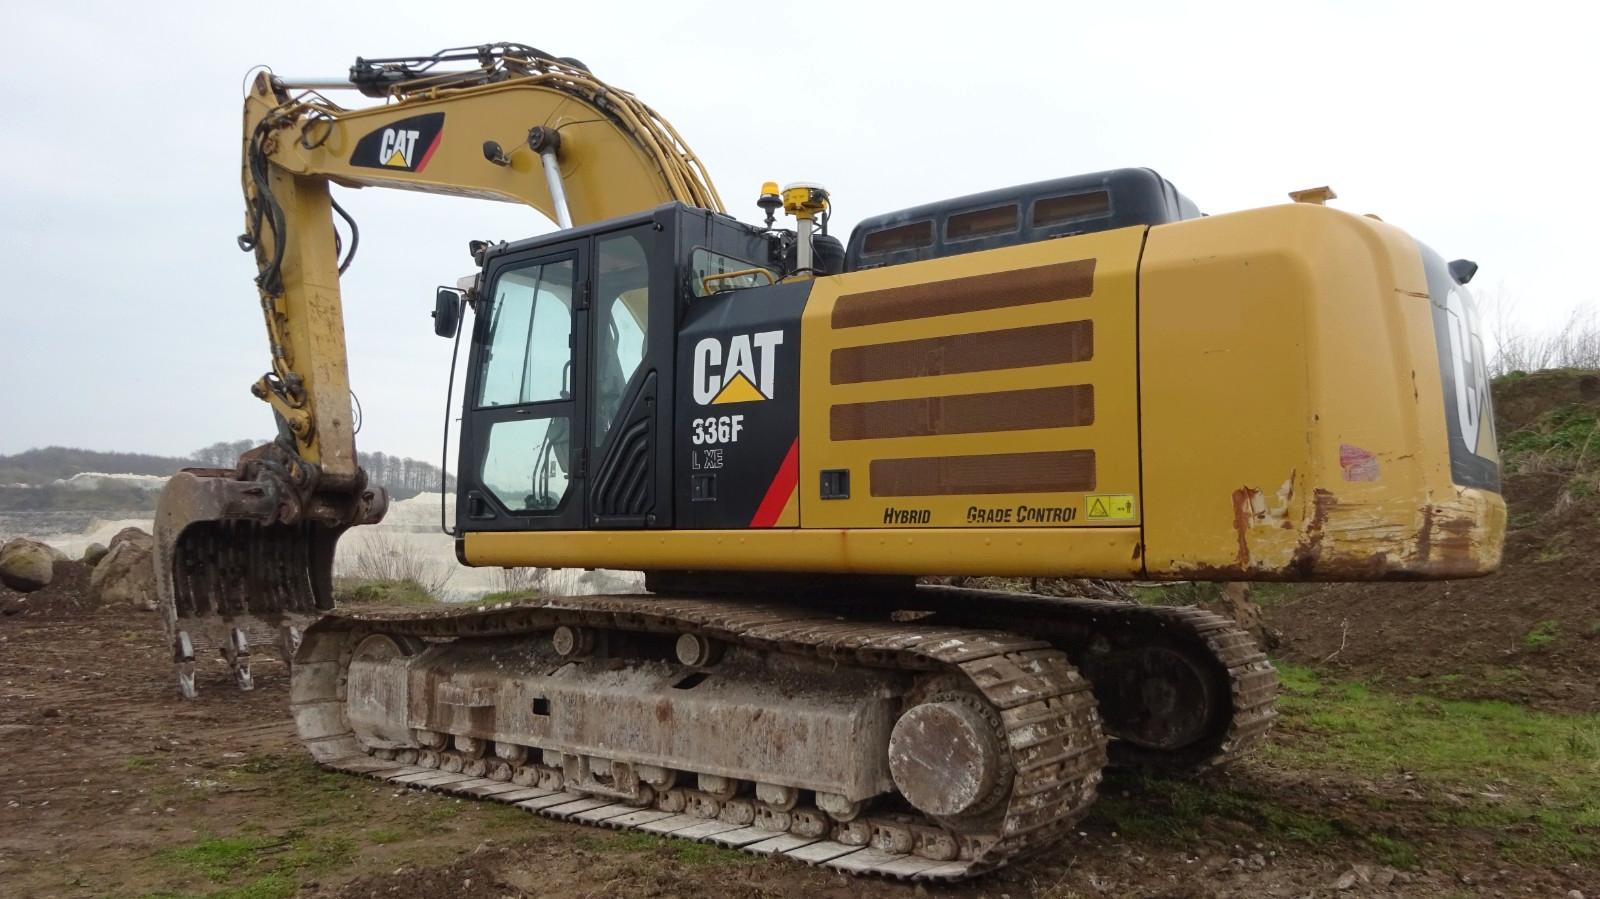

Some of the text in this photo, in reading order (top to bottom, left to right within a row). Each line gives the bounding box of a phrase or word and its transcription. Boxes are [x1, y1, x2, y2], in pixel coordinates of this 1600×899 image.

[379, 128, 420, 167] CAT
[692, 330, 784, 405] CAT
[692, 414, 744, 445] 336F
[692, 449, 724, 469] L XE
[883, 507, 931, 524] HYBRID
[967, 506, 1012, 523] GRADE
